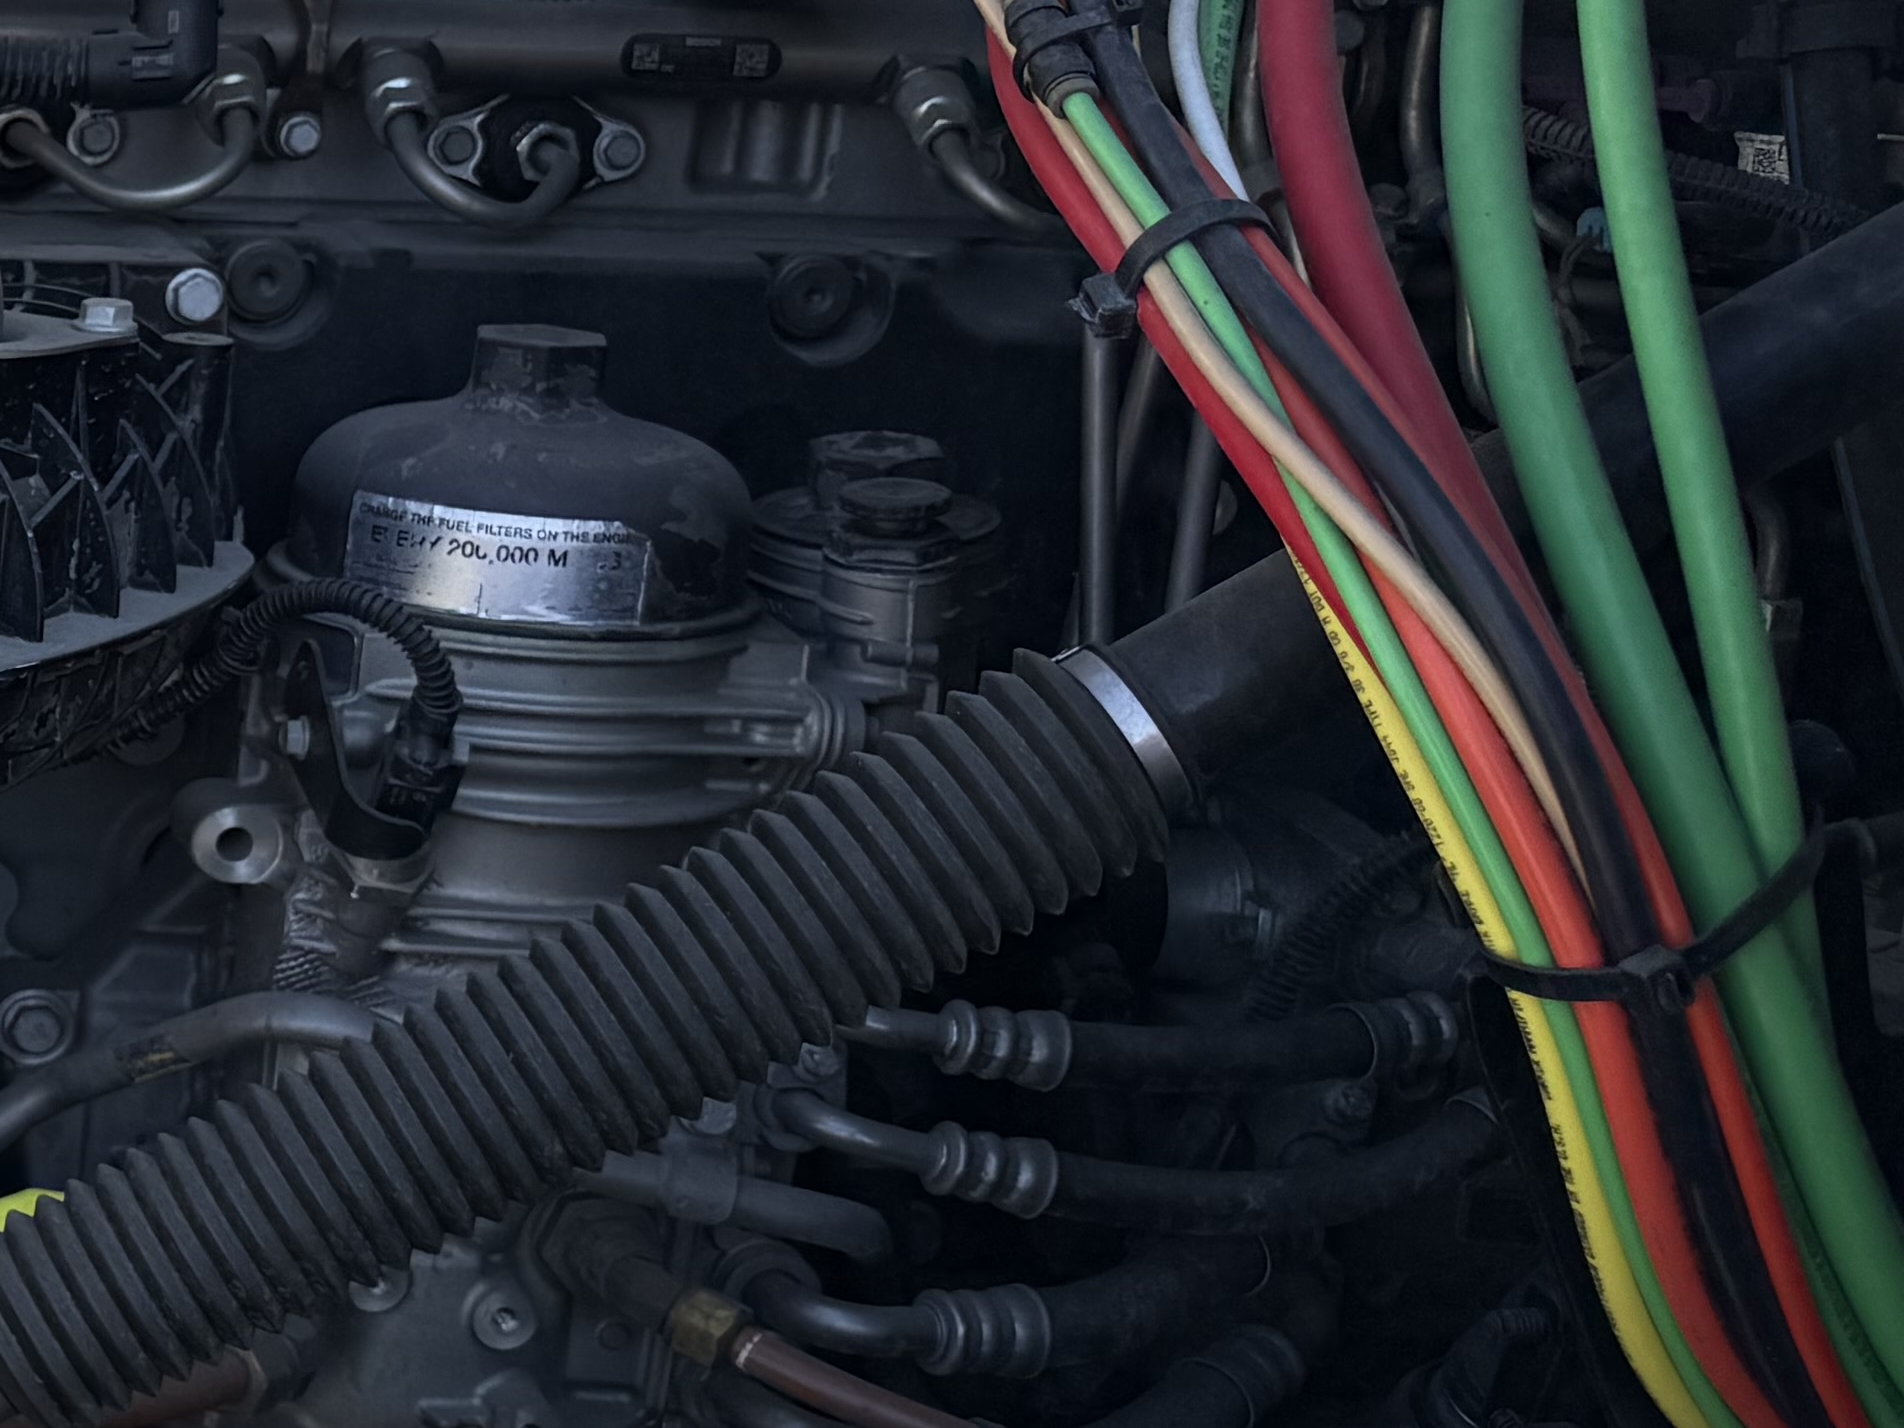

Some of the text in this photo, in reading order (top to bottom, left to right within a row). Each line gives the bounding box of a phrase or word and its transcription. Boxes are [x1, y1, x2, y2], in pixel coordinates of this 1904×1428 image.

[438, 517, 475, 534] FUEL
[476, 522, 533, 541] FILTERS
[537, 527, 560, 542] ON
[562, 530, 591, 544] THE
